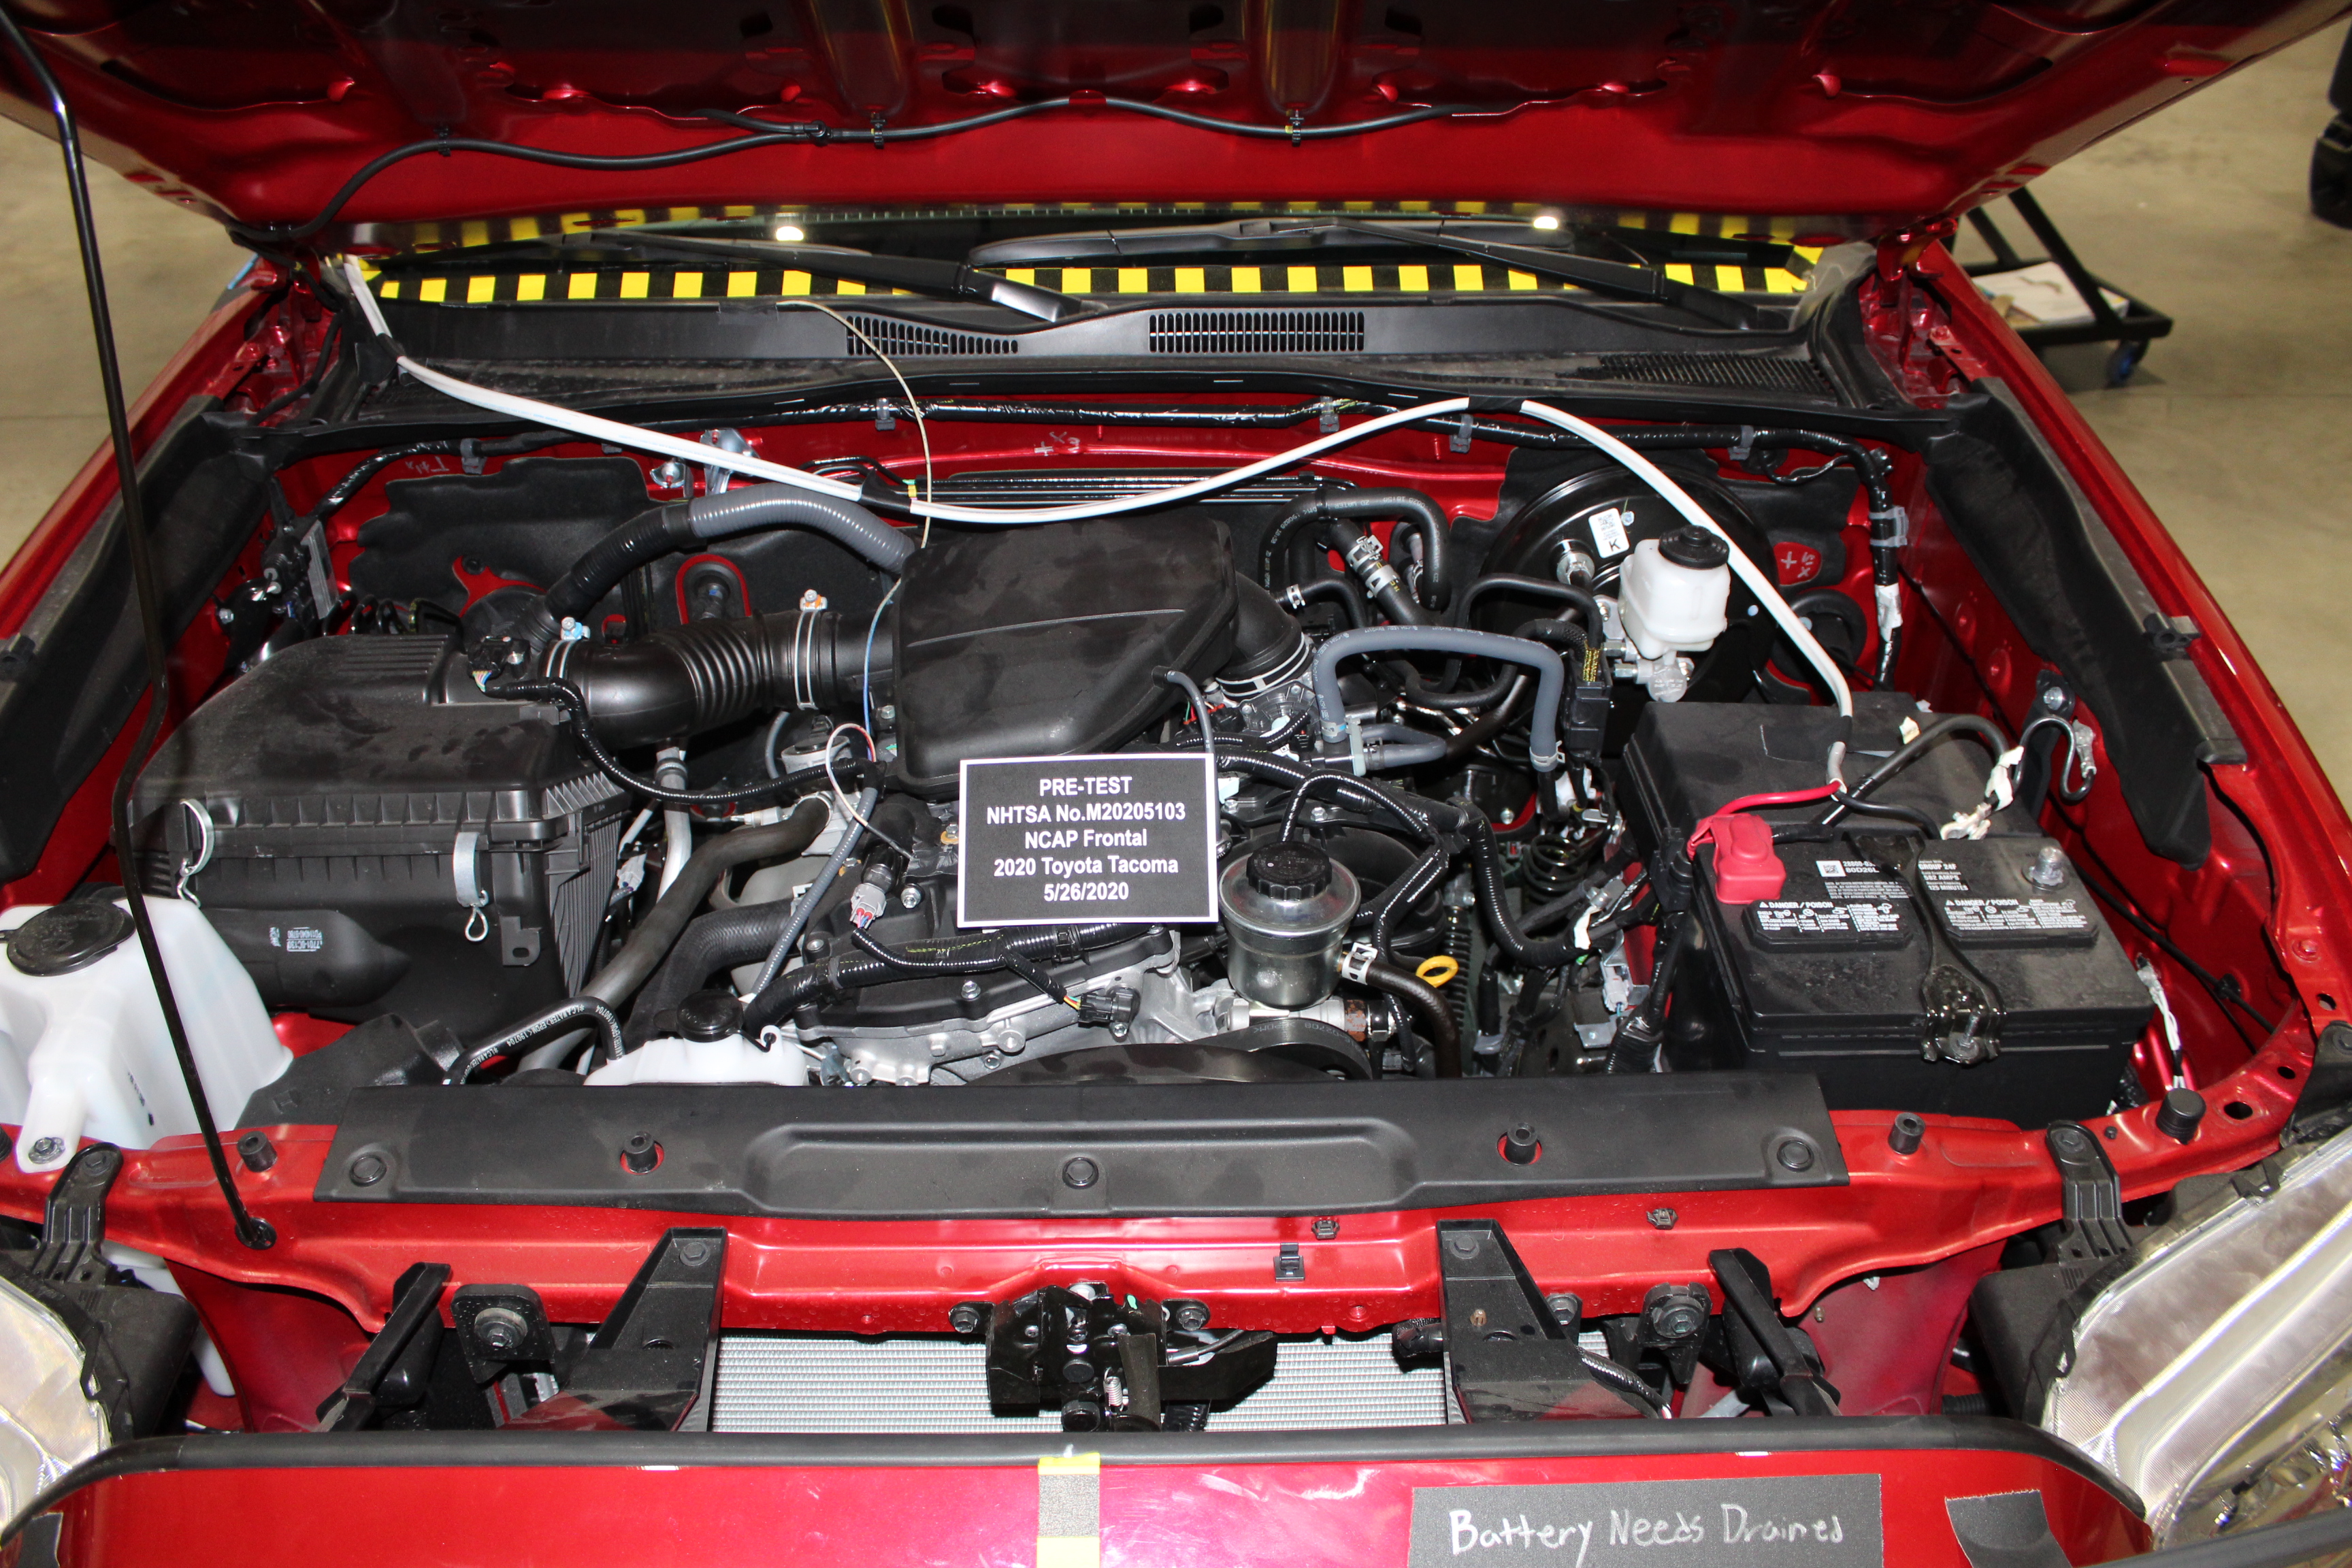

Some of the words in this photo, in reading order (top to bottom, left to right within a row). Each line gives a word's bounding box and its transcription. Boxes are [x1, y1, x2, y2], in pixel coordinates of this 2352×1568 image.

[1608, 538, 1622, 552] K
[1039, 777, 1132, 796] PRE-TEST
[987, 804, 1051, 824] NHTSA
[1056, 802, 1186, 822] No.M20205103
[1025, 830, 1078, 849] NCAP
[1083, 828, 1147, 847] Frontal
[994, 858, 1036, 877] 2020
[1041, 856, 1102, 878] Toyota
[1107, 855, 1179, 874] Tacoma
[1043, 882, 1129, 902] 5/26/2020
[1449, 1509, 1593, 1568] Battery
[1609, 1508, 1703, 1547] Needs
[1720, 1503, 1844, 1544] Drained
